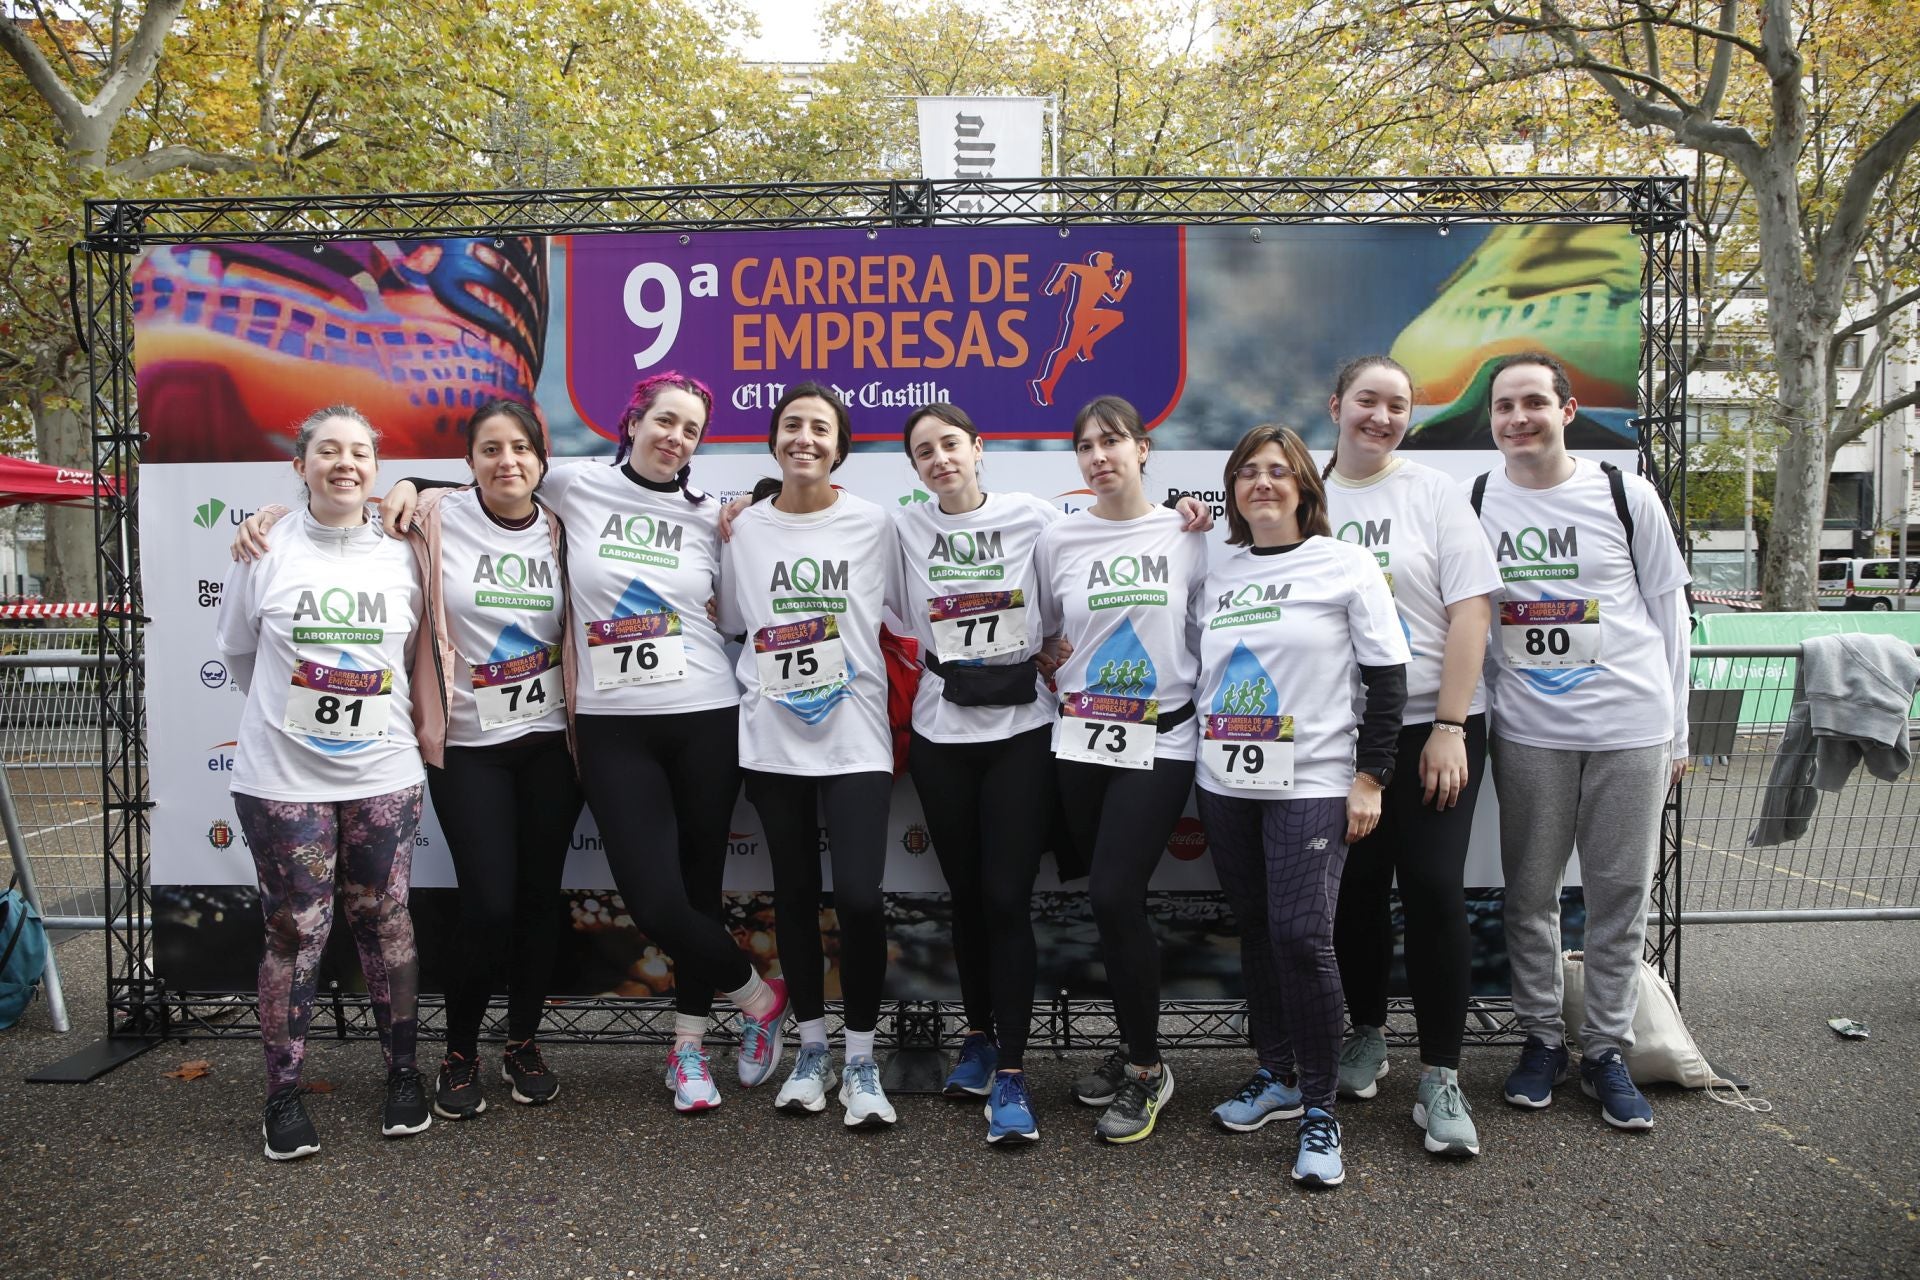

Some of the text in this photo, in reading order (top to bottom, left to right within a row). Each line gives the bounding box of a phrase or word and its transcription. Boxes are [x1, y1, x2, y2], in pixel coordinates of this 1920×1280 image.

[731, 253, 1030, 307] CARRERA DE
[733, 309, 1030, 371] EMPRESAS
[732, 383, 761, 411] El
[859, 381, 951, 408] Castilla
[601, 514, 683, 552] AQM
[927, 531, 1004, 566] AQM
[1497, 526, 1578, 563] AQM
[473, 553, 553, 592] AQM
[602, 548, 676, 566] LABORATORIOS
[1087, 555, 1169, 590] AQM
[770, 557, 848, 595] AQM
[931, 569, 1001, 578] LABORATORIOS
[1502, 568, 1576, 579] LABORATORIOS
[293, 588, 388, 627] AQM
[478, 594, 552, 608] LABORATORIOS
[775, 601, 844, 611] LABORATORIOS
[1091, 593, 1165, 607] LABORATORIOS
[956, 614, 1000, 646] 77
[1213, 610, 1278, 627] LABORATORIOS
[296, 631, 380, 641] LABORATORIOS
[1525, 628, 1570, 656] 80
[613, 643, 659, 673] 76
[775, 647, 819, 680] 75
[500, 678, 546, 712] 74
[315, 695, 364, 727] 81
[1084, 722, 1127, 753] 73
[1222, 744, 1265, 774] 79
